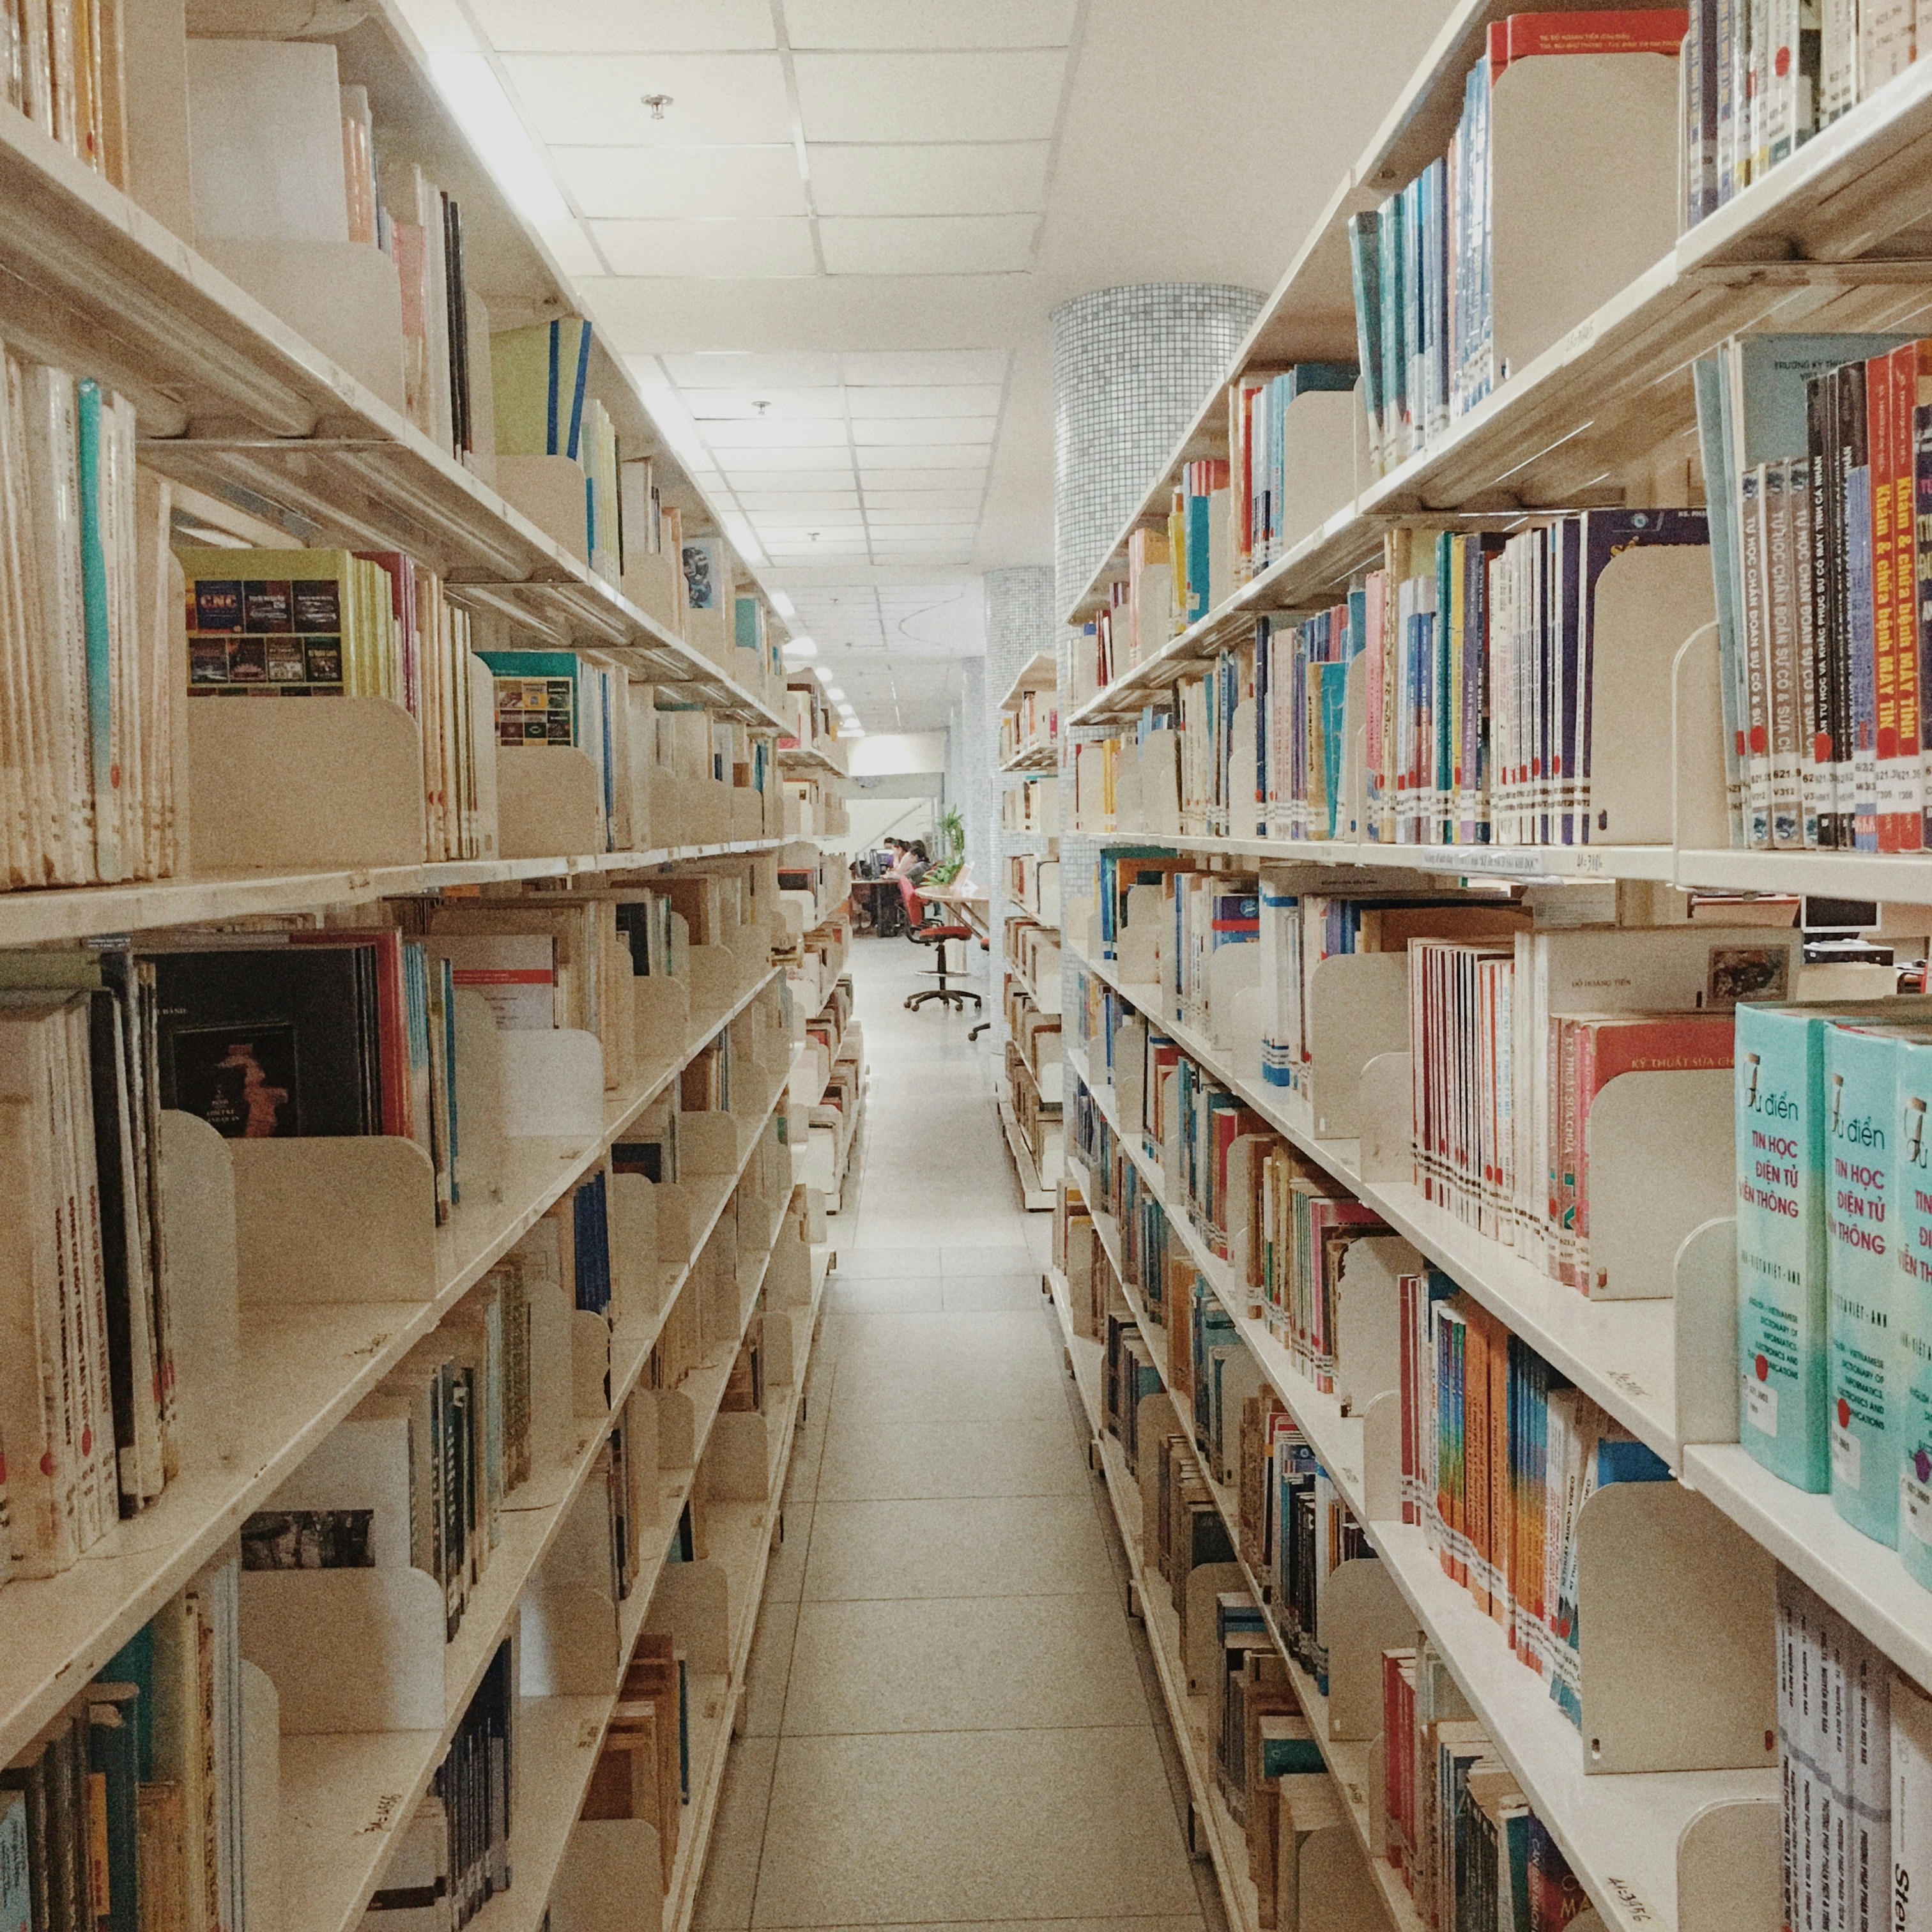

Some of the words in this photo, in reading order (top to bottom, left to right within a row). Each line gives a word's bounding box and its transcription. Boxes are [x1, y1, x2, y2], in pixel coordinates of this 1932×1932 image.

[1876, 541, 1892, 555] &
[1897, 535, 1912, 549] &
[200, 594, 239, 609] CNC
[1751, 695, 1760, 703] &
[1777, 693, 1790, 702] &
[1804, 693, 1815, 703] &
[1879, 700, 1896, 729] TÍN
[1765, 1091, 1798, 1121] điển
[1752, 1130, 1766, 1150] TIN
[1768, 1135, 1798, 1159] HỌC
[1847, 1116, 1885, 1150] điển
[1755, 1160, 1781, 1184] ĐIỆN
[1834, 1157, 1848, 1179] TIN
[1851, 1163, 1885, 1191] HỌC
[1756, 1190, 1799, 1218] THÔNG
[1837, 1190, 1864, 1218] ĐIỆN
[1838, 1221, 1885, 1255] THÔNG
